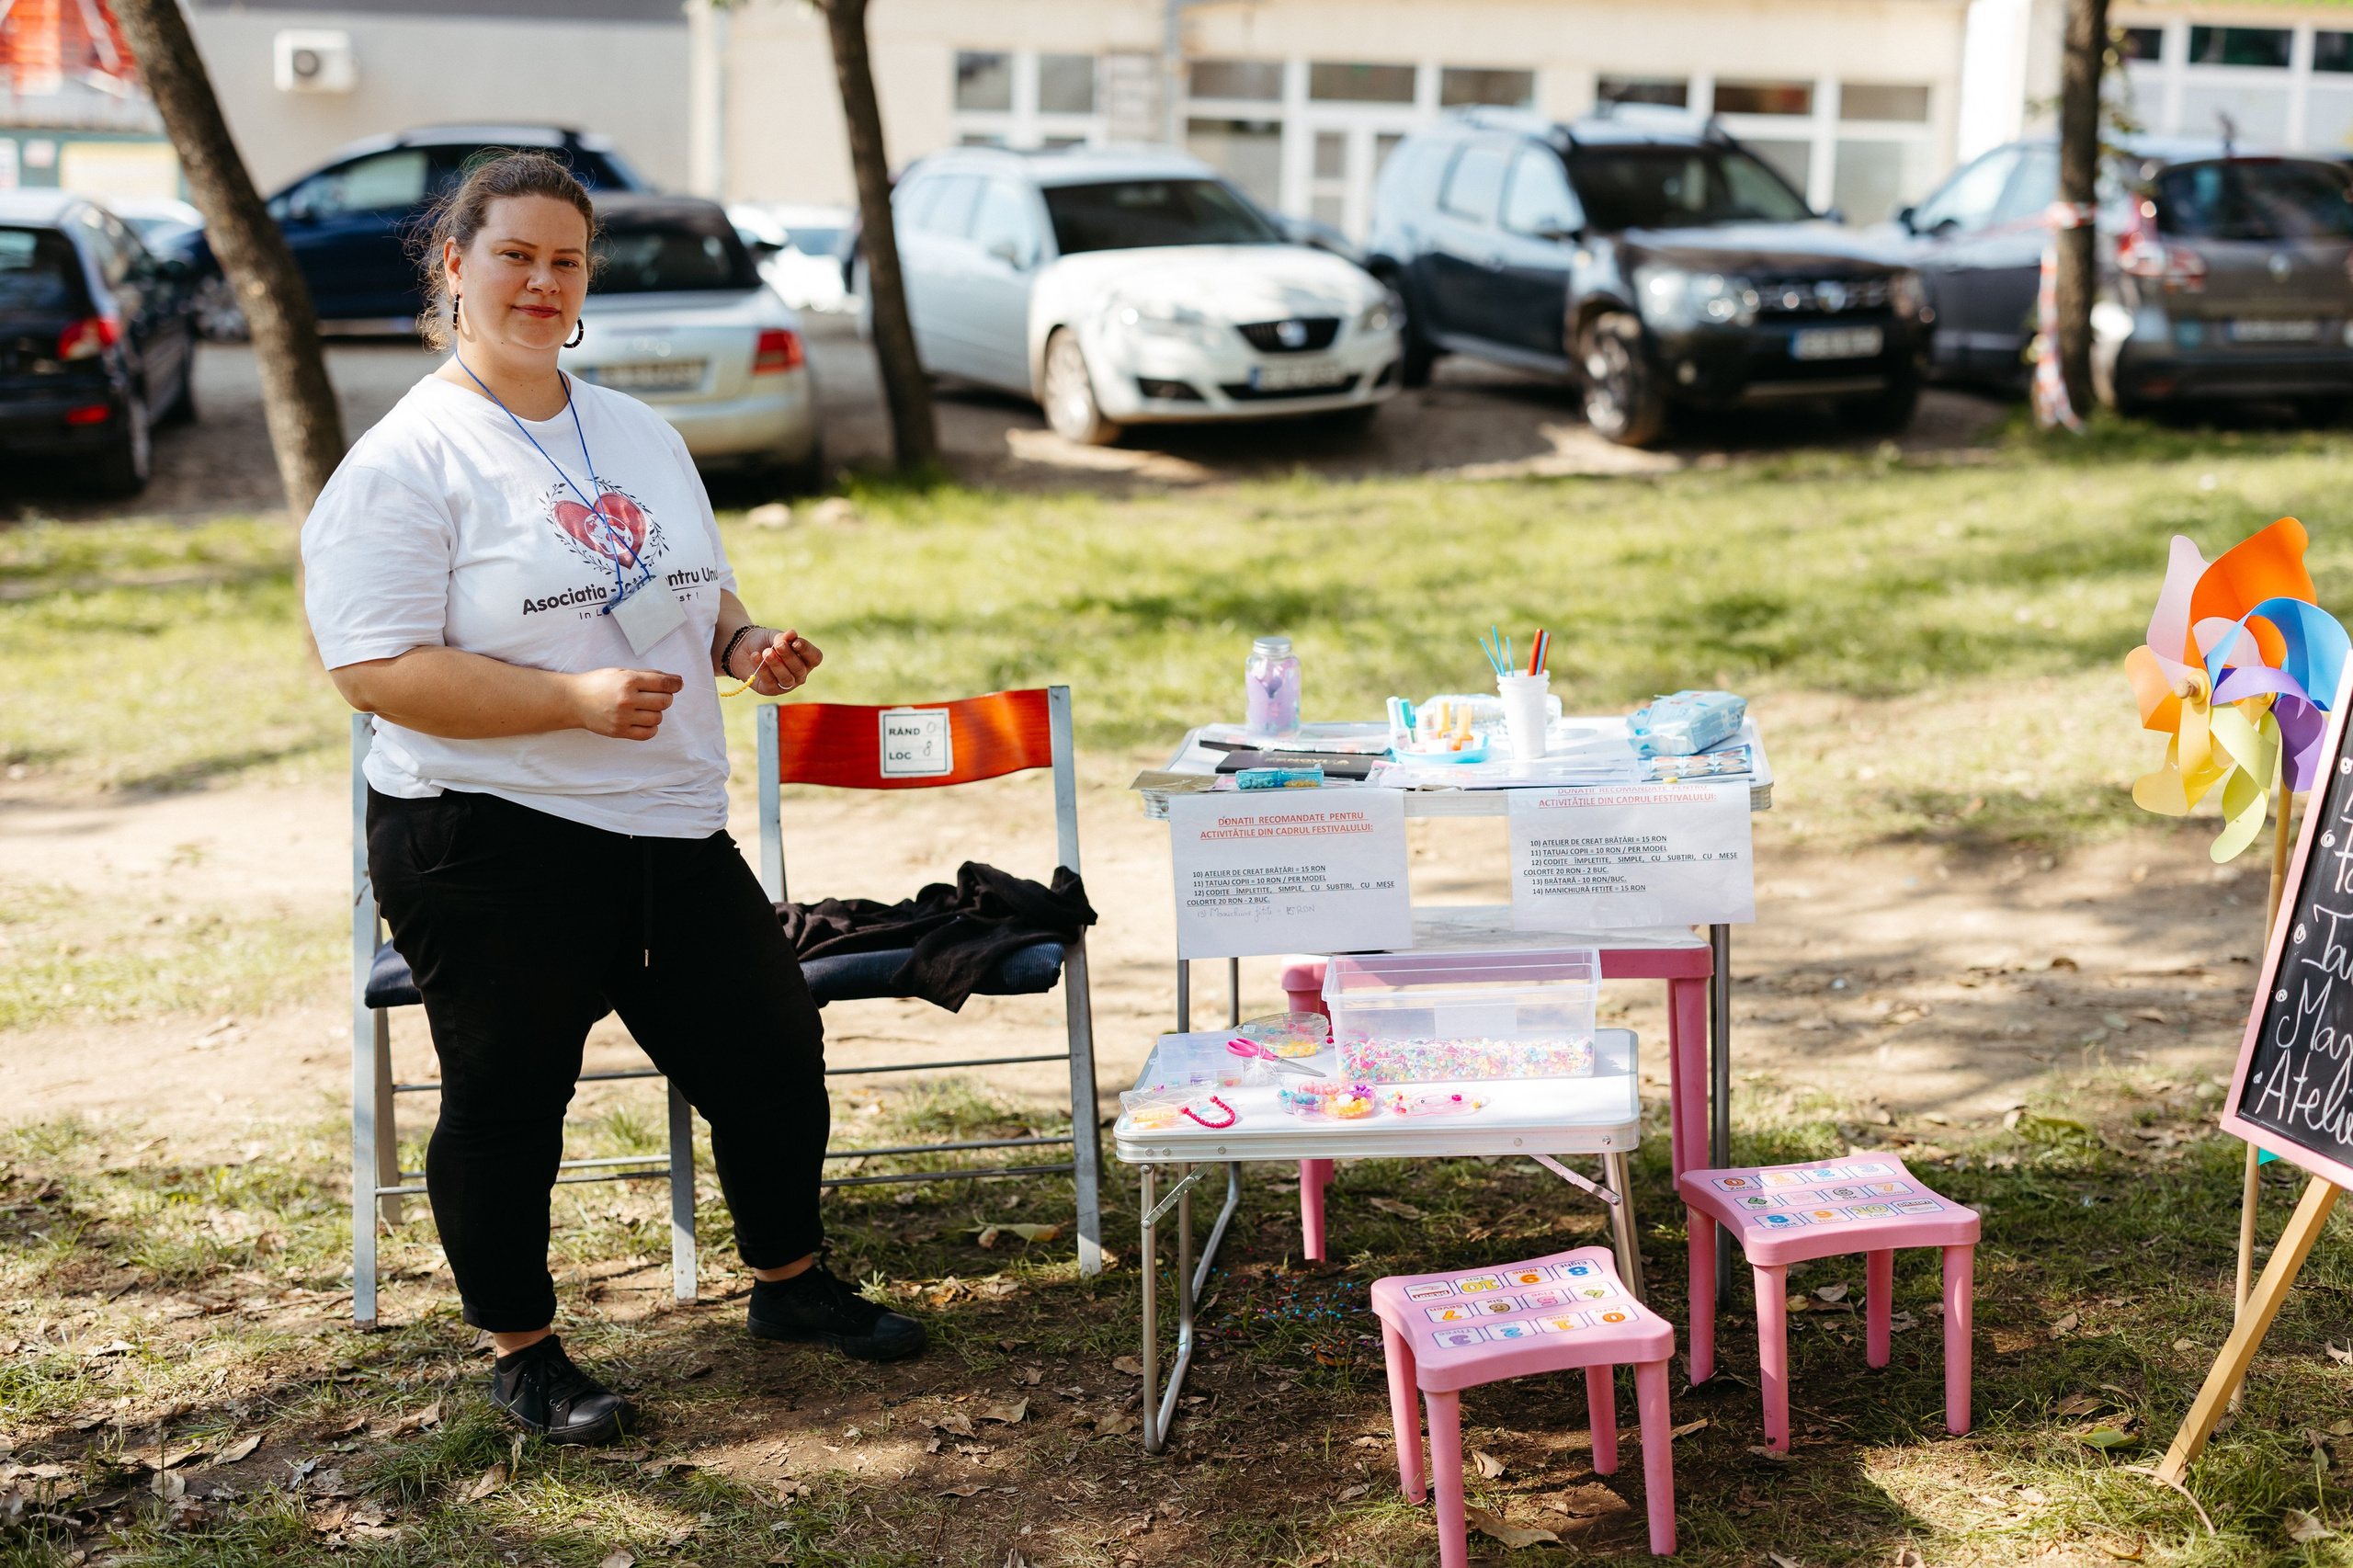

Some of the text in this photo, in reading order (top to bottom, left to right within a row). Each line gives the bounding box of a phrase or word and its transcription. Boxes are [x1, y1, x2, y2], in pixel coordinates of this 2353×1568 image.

[523, 582, 608, 615] Asociatia
[579, 611, 592, 620] In
[676, 593, 692, 602] st
[889, 752, 912, 760] LOC
[1599, 785, 1666, 793] RECOMANDATE
[1616, 796, 1651, 805] CADRUL
[1654, 793, 1717, 802] FESTIVALULUI:
[1258, 813, 1324, 824] RECOMANDATE
[1329, 812, 1364, 821] PENTRU
[1257, 828, 1274, 836] DIN
[1276, 826, 1310, 835] CADRUL
[1312, 824, 1373, 834] FESTIVALULUI:
[1618, 855, 1644, 863] SIMPLE,
[1205, 869, 1231, 878] ATELIER
[1243, 868, 1264, 876] CREAT
[1592, 875, 1627, 883] RON/BUC.
[1544, 886, 1590, 894] MANICHIURĂ
[1768, 1174, 1790, 1182] 1
[1813, 1169, 1836, 1177] 2
[1724, 1178, 1745, 1187] 0
[1875, 1183, 1893, 1192] 7
[1833, 1187, 1853, 1196] 6
[1813, 1210, 1833, 1219] 9
[1850, 1204, 1889, 1215] 10
[1767, 1215, 1790, 1223] 8
[1559, 1260, 1587, 1268] Eight
[1512, 1267, 1538, 1276] Nine
[1567, 1266, 1589, 1276] 8
[1519, 1274, 1540, 1284] 9
[1461, 1279, 1499, 1293] 10
[1583, 1289, 1605, 1299] 4
[1537, 1295, 1558, 1307] 5
[1489, 1302, 1510, 1313] 6
[1442, 1310, 1462, 1321] 7
[1602, 1312, 1626, 1323] 0
[1552, 1319, 1574, 1331] 1
[1500, 1327, 1523, 1338] 2
[1449, 1335, 1472, 1345] 3
